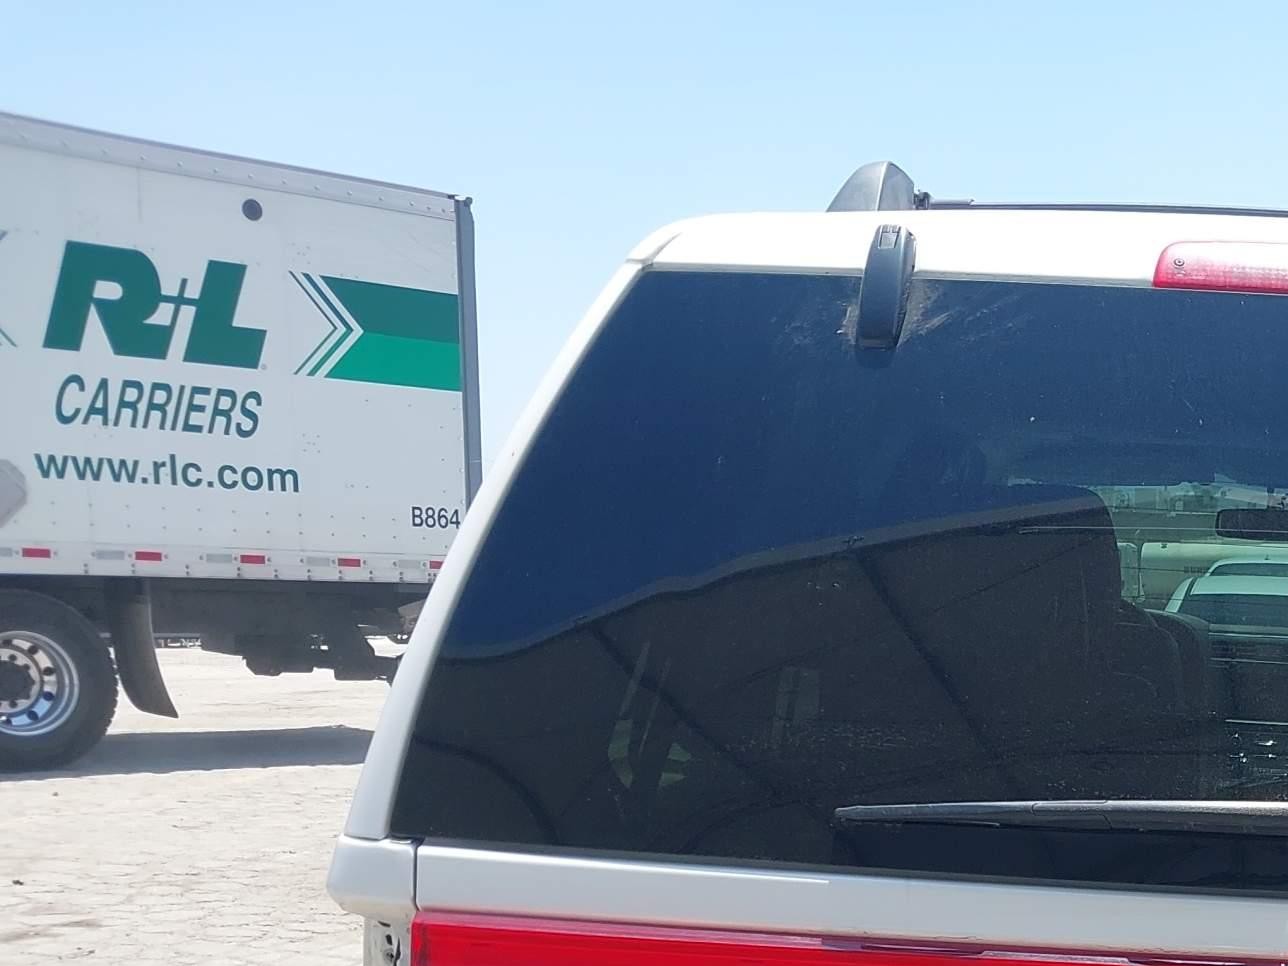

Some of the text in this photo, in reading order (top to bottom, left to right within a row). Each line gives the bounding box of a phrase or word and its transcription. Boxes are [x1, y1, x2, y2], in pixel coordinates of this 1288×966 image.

[55, 373, 263, 439] CARRIERS
[34, 453, 300, 493] www.rlc.com
[411, 506, 461, 529] B864
